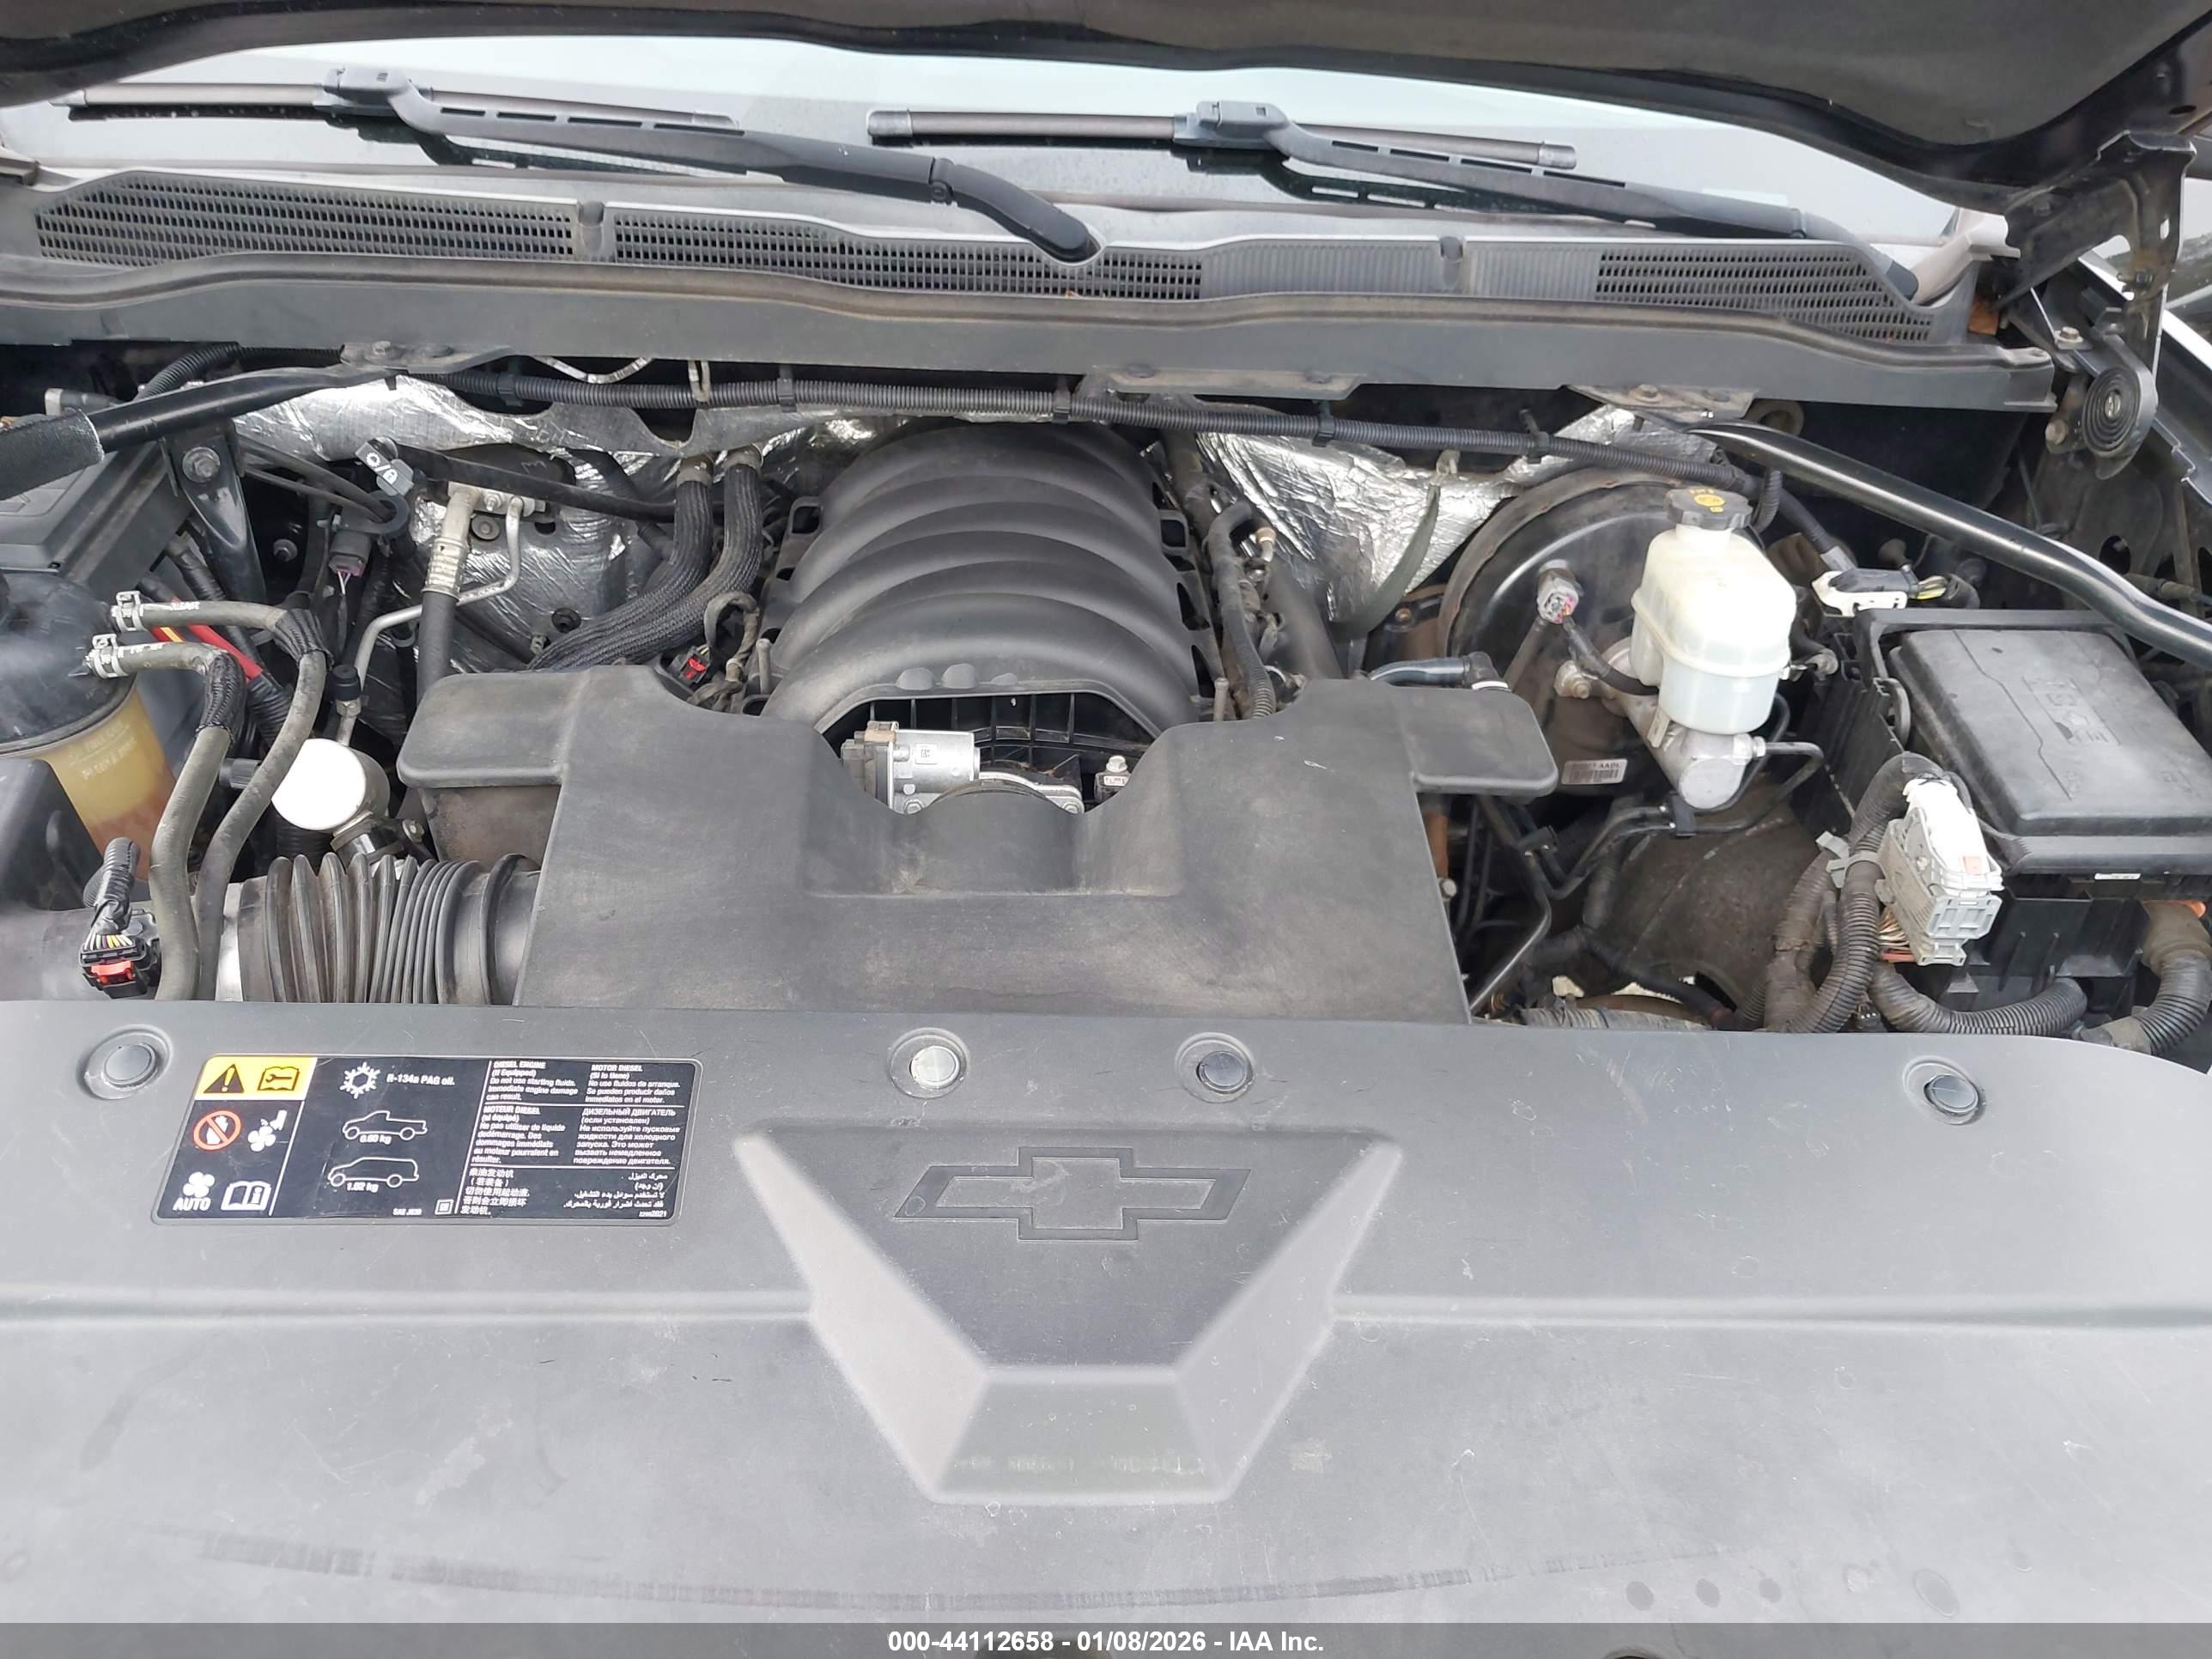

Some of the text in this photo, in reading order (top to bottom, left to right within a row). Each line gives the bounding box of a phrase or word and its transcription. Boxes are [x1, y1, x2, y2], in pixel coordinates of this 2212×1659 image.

[421, 1075, 441, 1085] PAG
[380, 1135, 392, 1145] kg
[367, 1182, 379, 1193] kg
[173, 1197, 211, 1211] AUTO
